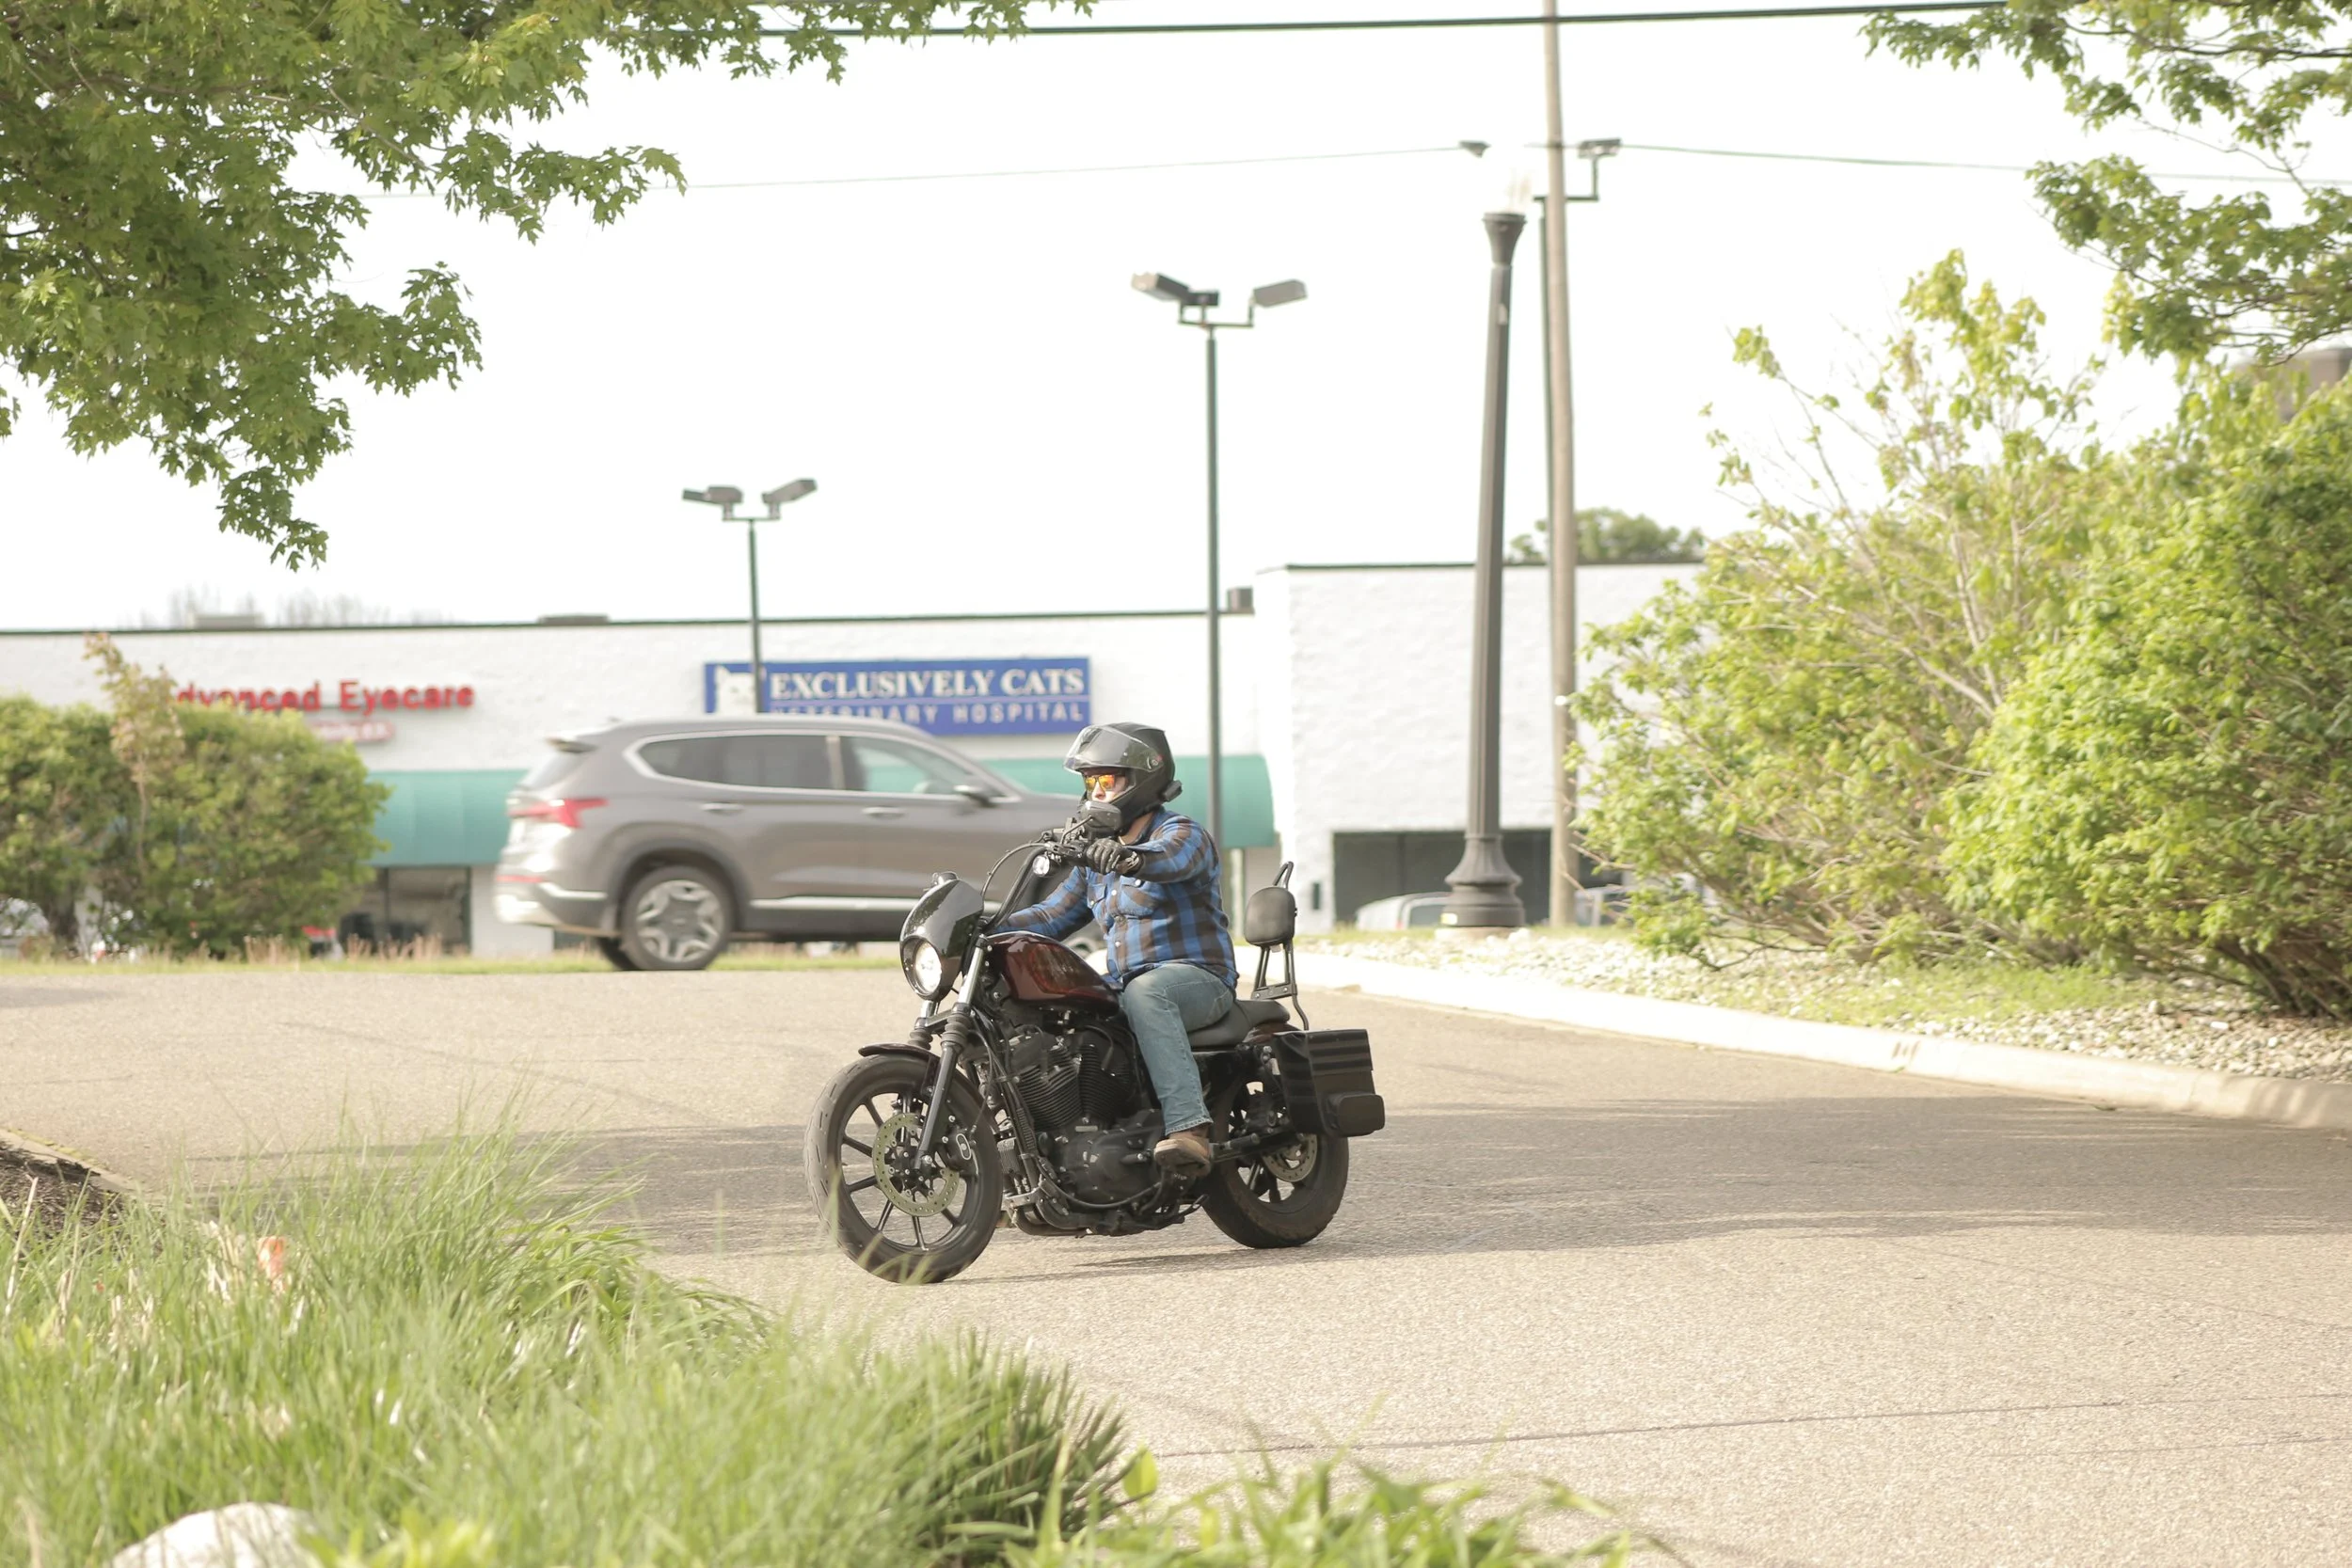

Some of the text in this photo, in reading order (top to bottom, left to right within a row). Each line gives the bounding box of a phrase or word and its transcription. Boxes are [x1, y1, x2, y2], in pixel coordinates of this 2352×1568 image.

[167, 678, 474, 717] dvanced Eyecare
[771, 667, 1085, 699] EXCLUSIVELY CATS
[952, 702, 1083, 724] HOSPITAL
